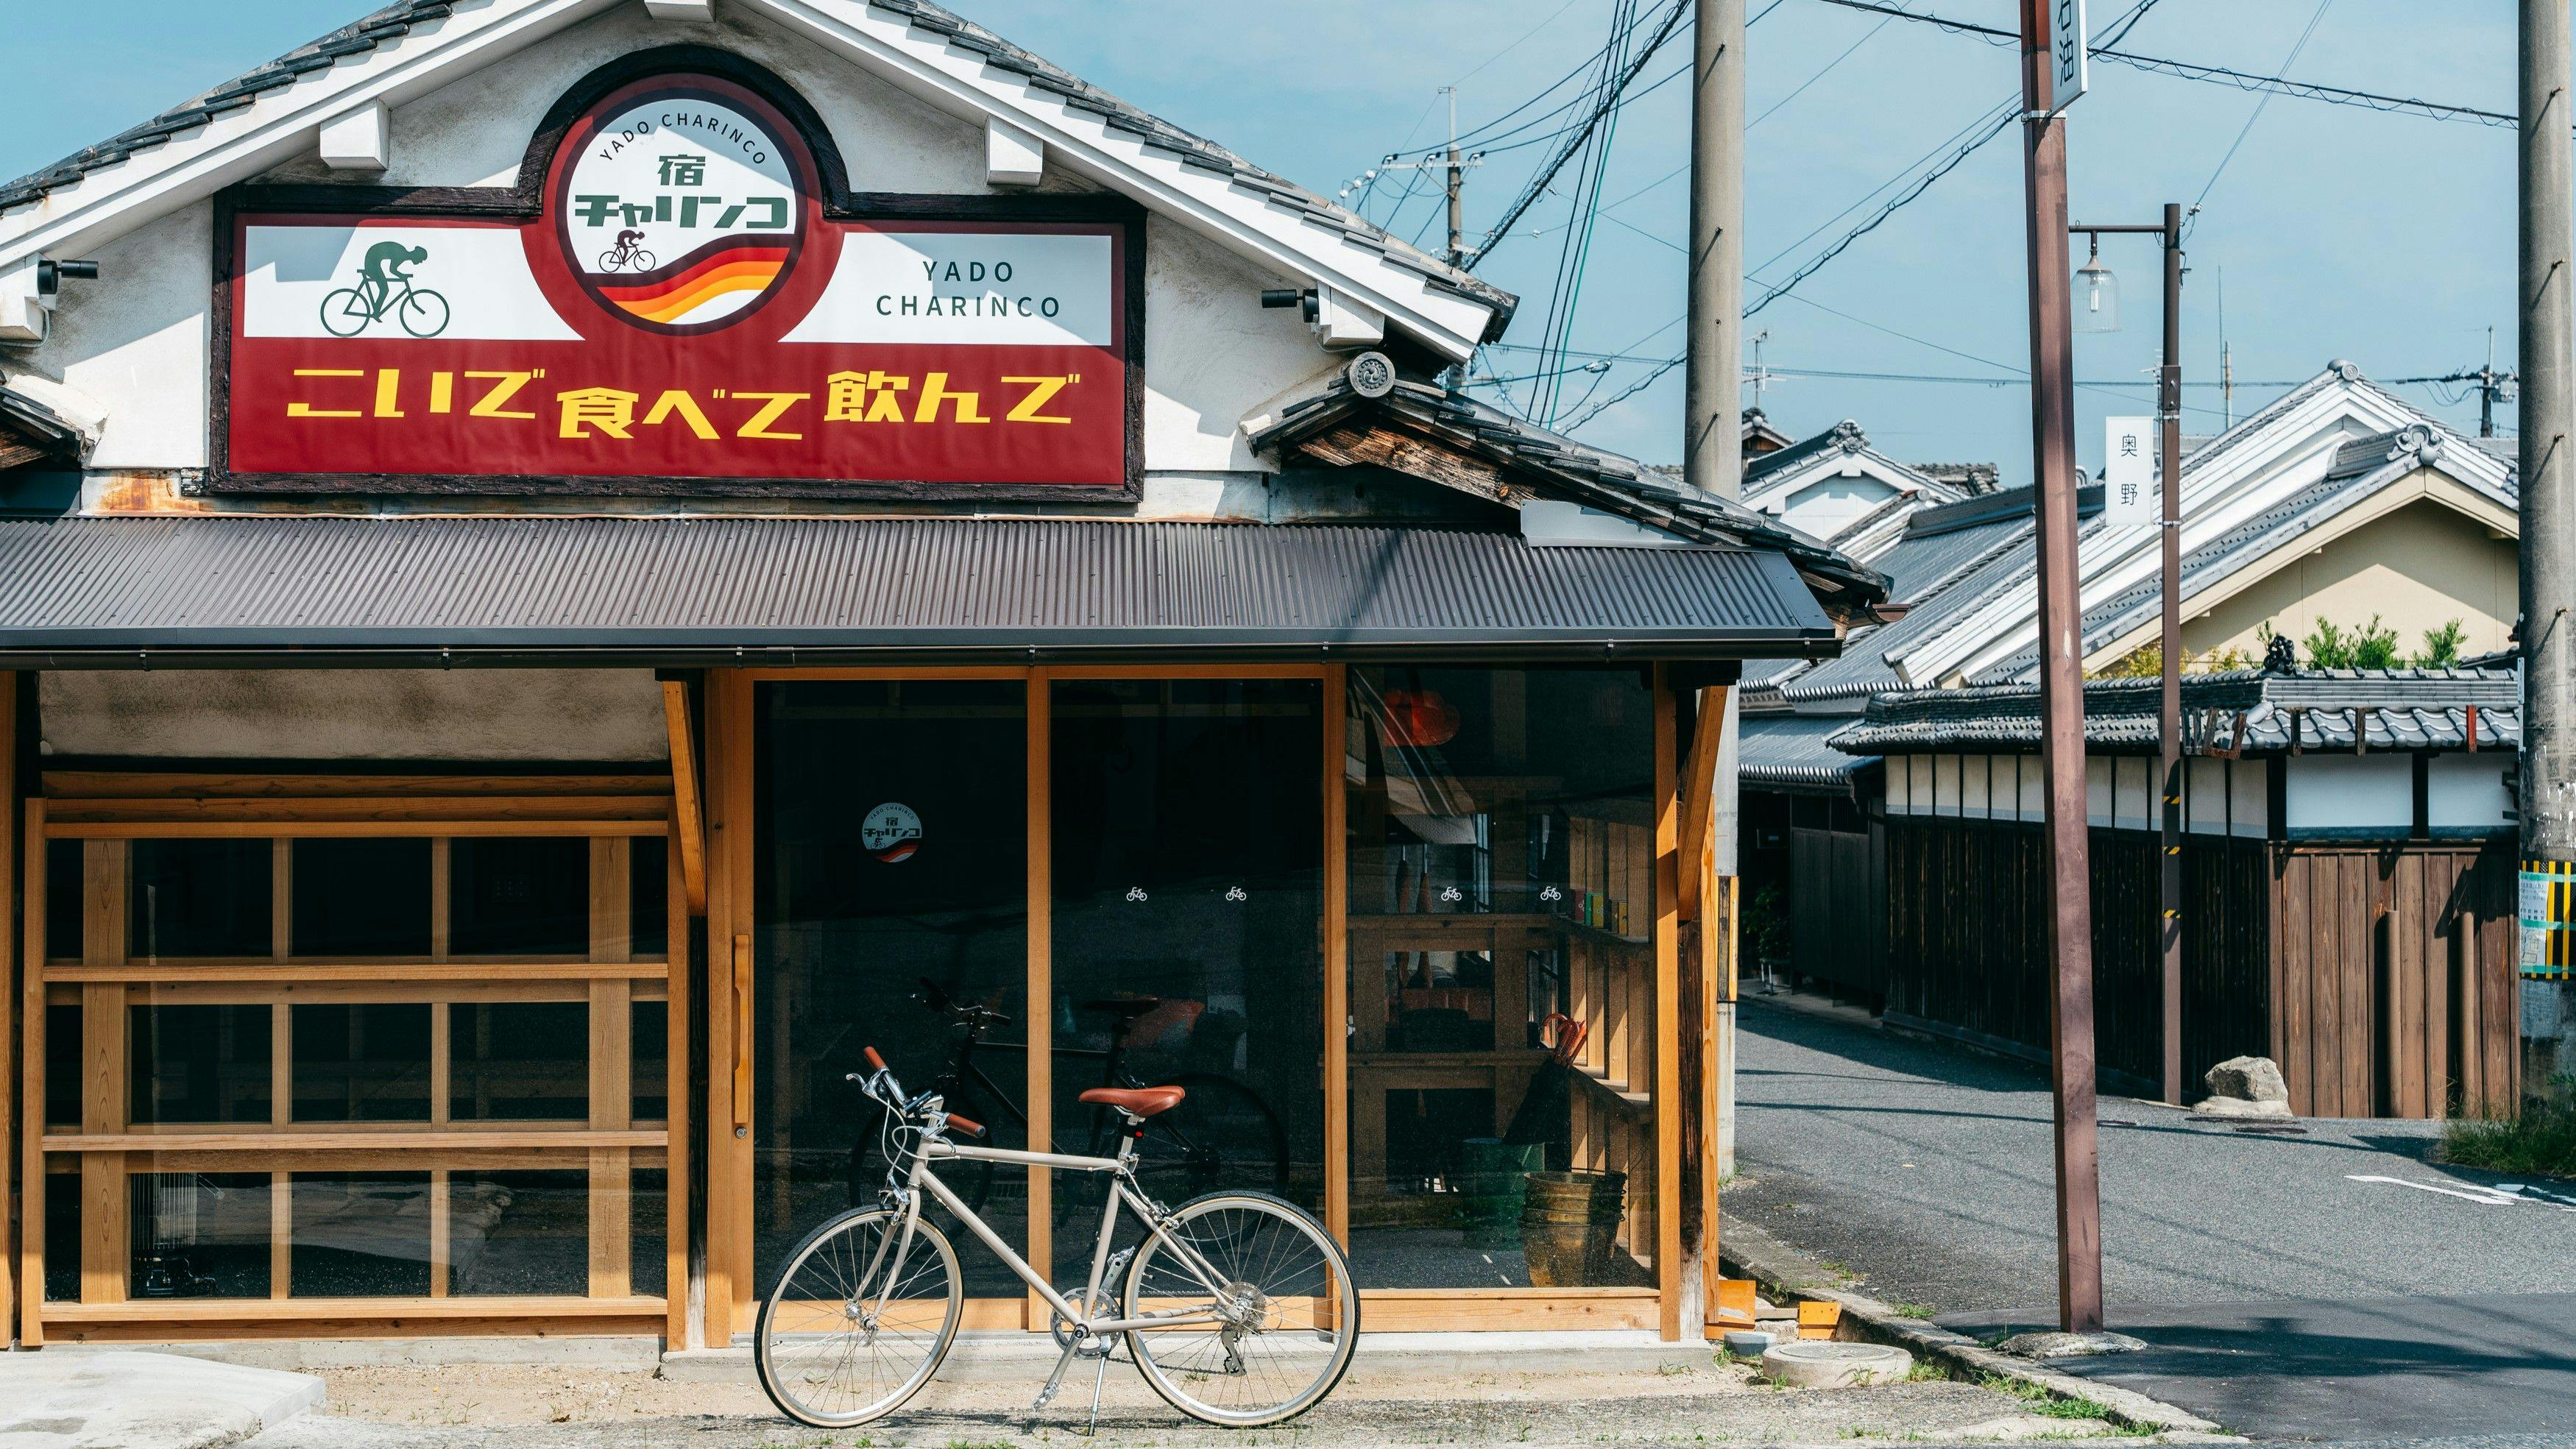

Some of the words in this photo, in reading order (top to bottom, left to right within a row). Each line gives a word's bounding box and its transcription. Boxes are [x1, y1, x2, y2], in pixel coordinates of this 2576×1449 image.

[599, 121, 649, 162] YADO
[662, 113, 766, 165] CHARINCO
[657, 154, 707, 186] 宿
[575, 195, 788, 229] チャリンコ
[922, 261, 1013, 283] YADO
[876, 295, 1060, 318] CHARINCO
[2120, 433, 2138, 506] 奥野
[885, 806, 915, 821] CHARINCO
[885, 817, 899, 826] 宿
[863, 828, 921, 837] チャリンコ
